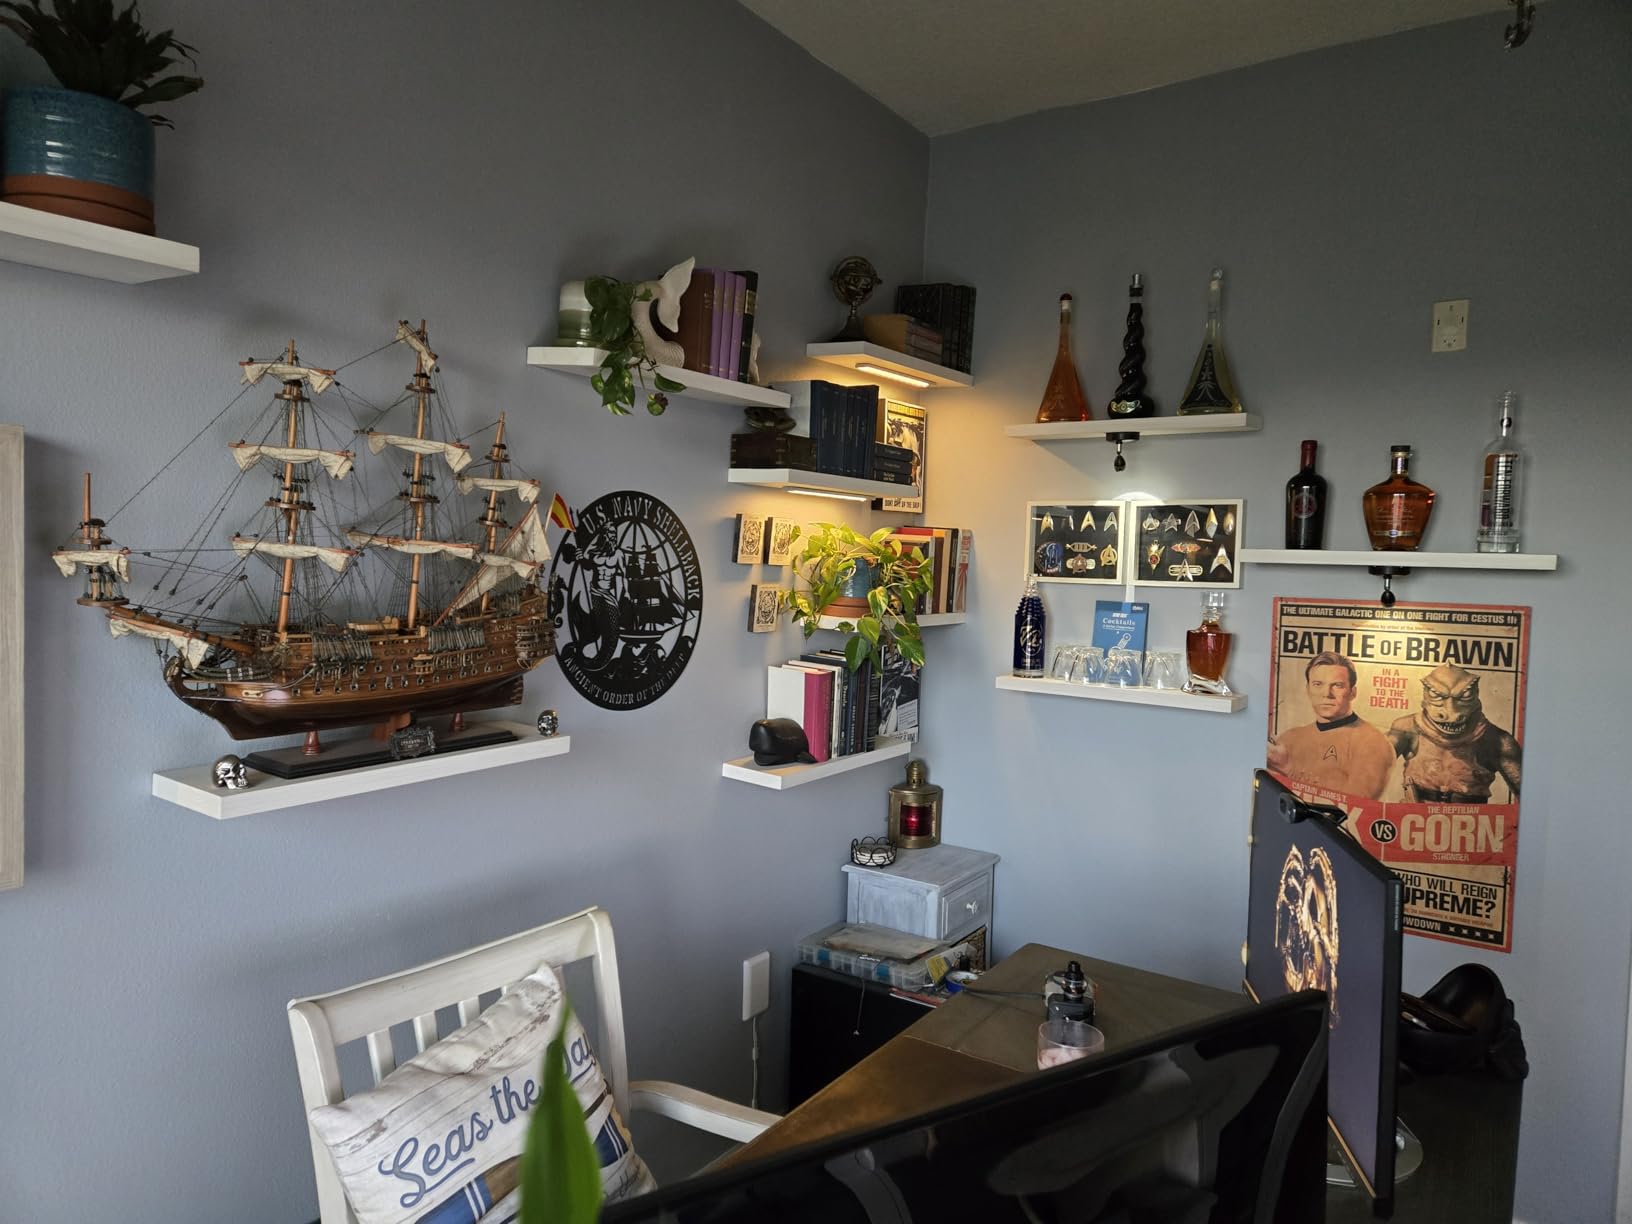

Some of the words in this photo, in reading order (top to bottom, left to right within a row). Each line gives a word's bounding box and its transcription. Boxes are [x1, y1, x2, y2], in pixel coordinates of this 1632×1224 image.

[582, 504, 610, 534] U.S.
[612, 496, 653, 519] NAVY
[653, 506, 700, 600] SHELLBACK
[1102, 617, 1136, 626] Cocktails
[1282, 606, 1297, 614] THE
[1298, 607, 1334, 616] ULTIMATE
[1335, 608, 1373, 617] GALACTIC
[1375, 610, 1391, 619] ONE
[1392, 611, 1405, 620] ON
[1407, 611, 1423, 620] ONE
[1425, 612, 1450, 621] FIGHT
[1452, 613, 1469, 622] FOR
[1471, 614, 1505, 624] CESTUS
[1282, 630, 1375, 658] BATTLE
[1380, 640, 1402, 656] OF
[1406, 637, 1514, 667] BRAWN
[564, 657, 602, 698] ANCIENT
[602, 690, 634, 704] ORDER
[636, 688, 650, 702] OF
[1382, 668, 1391, 676] IN
[1373, 676, 1409, 689] FIGHT
[1376, 688, 1386, 696] TO
[1390, 689, 1405, 697] THE
[1370, 696, 1409, 710] DEATH
[1291, 782, 1318, 795] CAPTAIN
[1320, 789, 1341, 801] JAMES
[1427, 806, 1441, 814] THE
[1442, 806, 1480, 814] REPTILIAN
[1375, 822, 1393, 840] VS
[1400, 814, 1504, 853] GORN
[1395, 871, 1421, 888] WHO
[1426, 878, 1456, 893] WILL
[1461, 883, 1497, 900] REIGN
[1403, 886, 1496, 919] UPREME?
[378, 1110, 493, 1208] Seas
[490, 1076, 543, 1124] the
